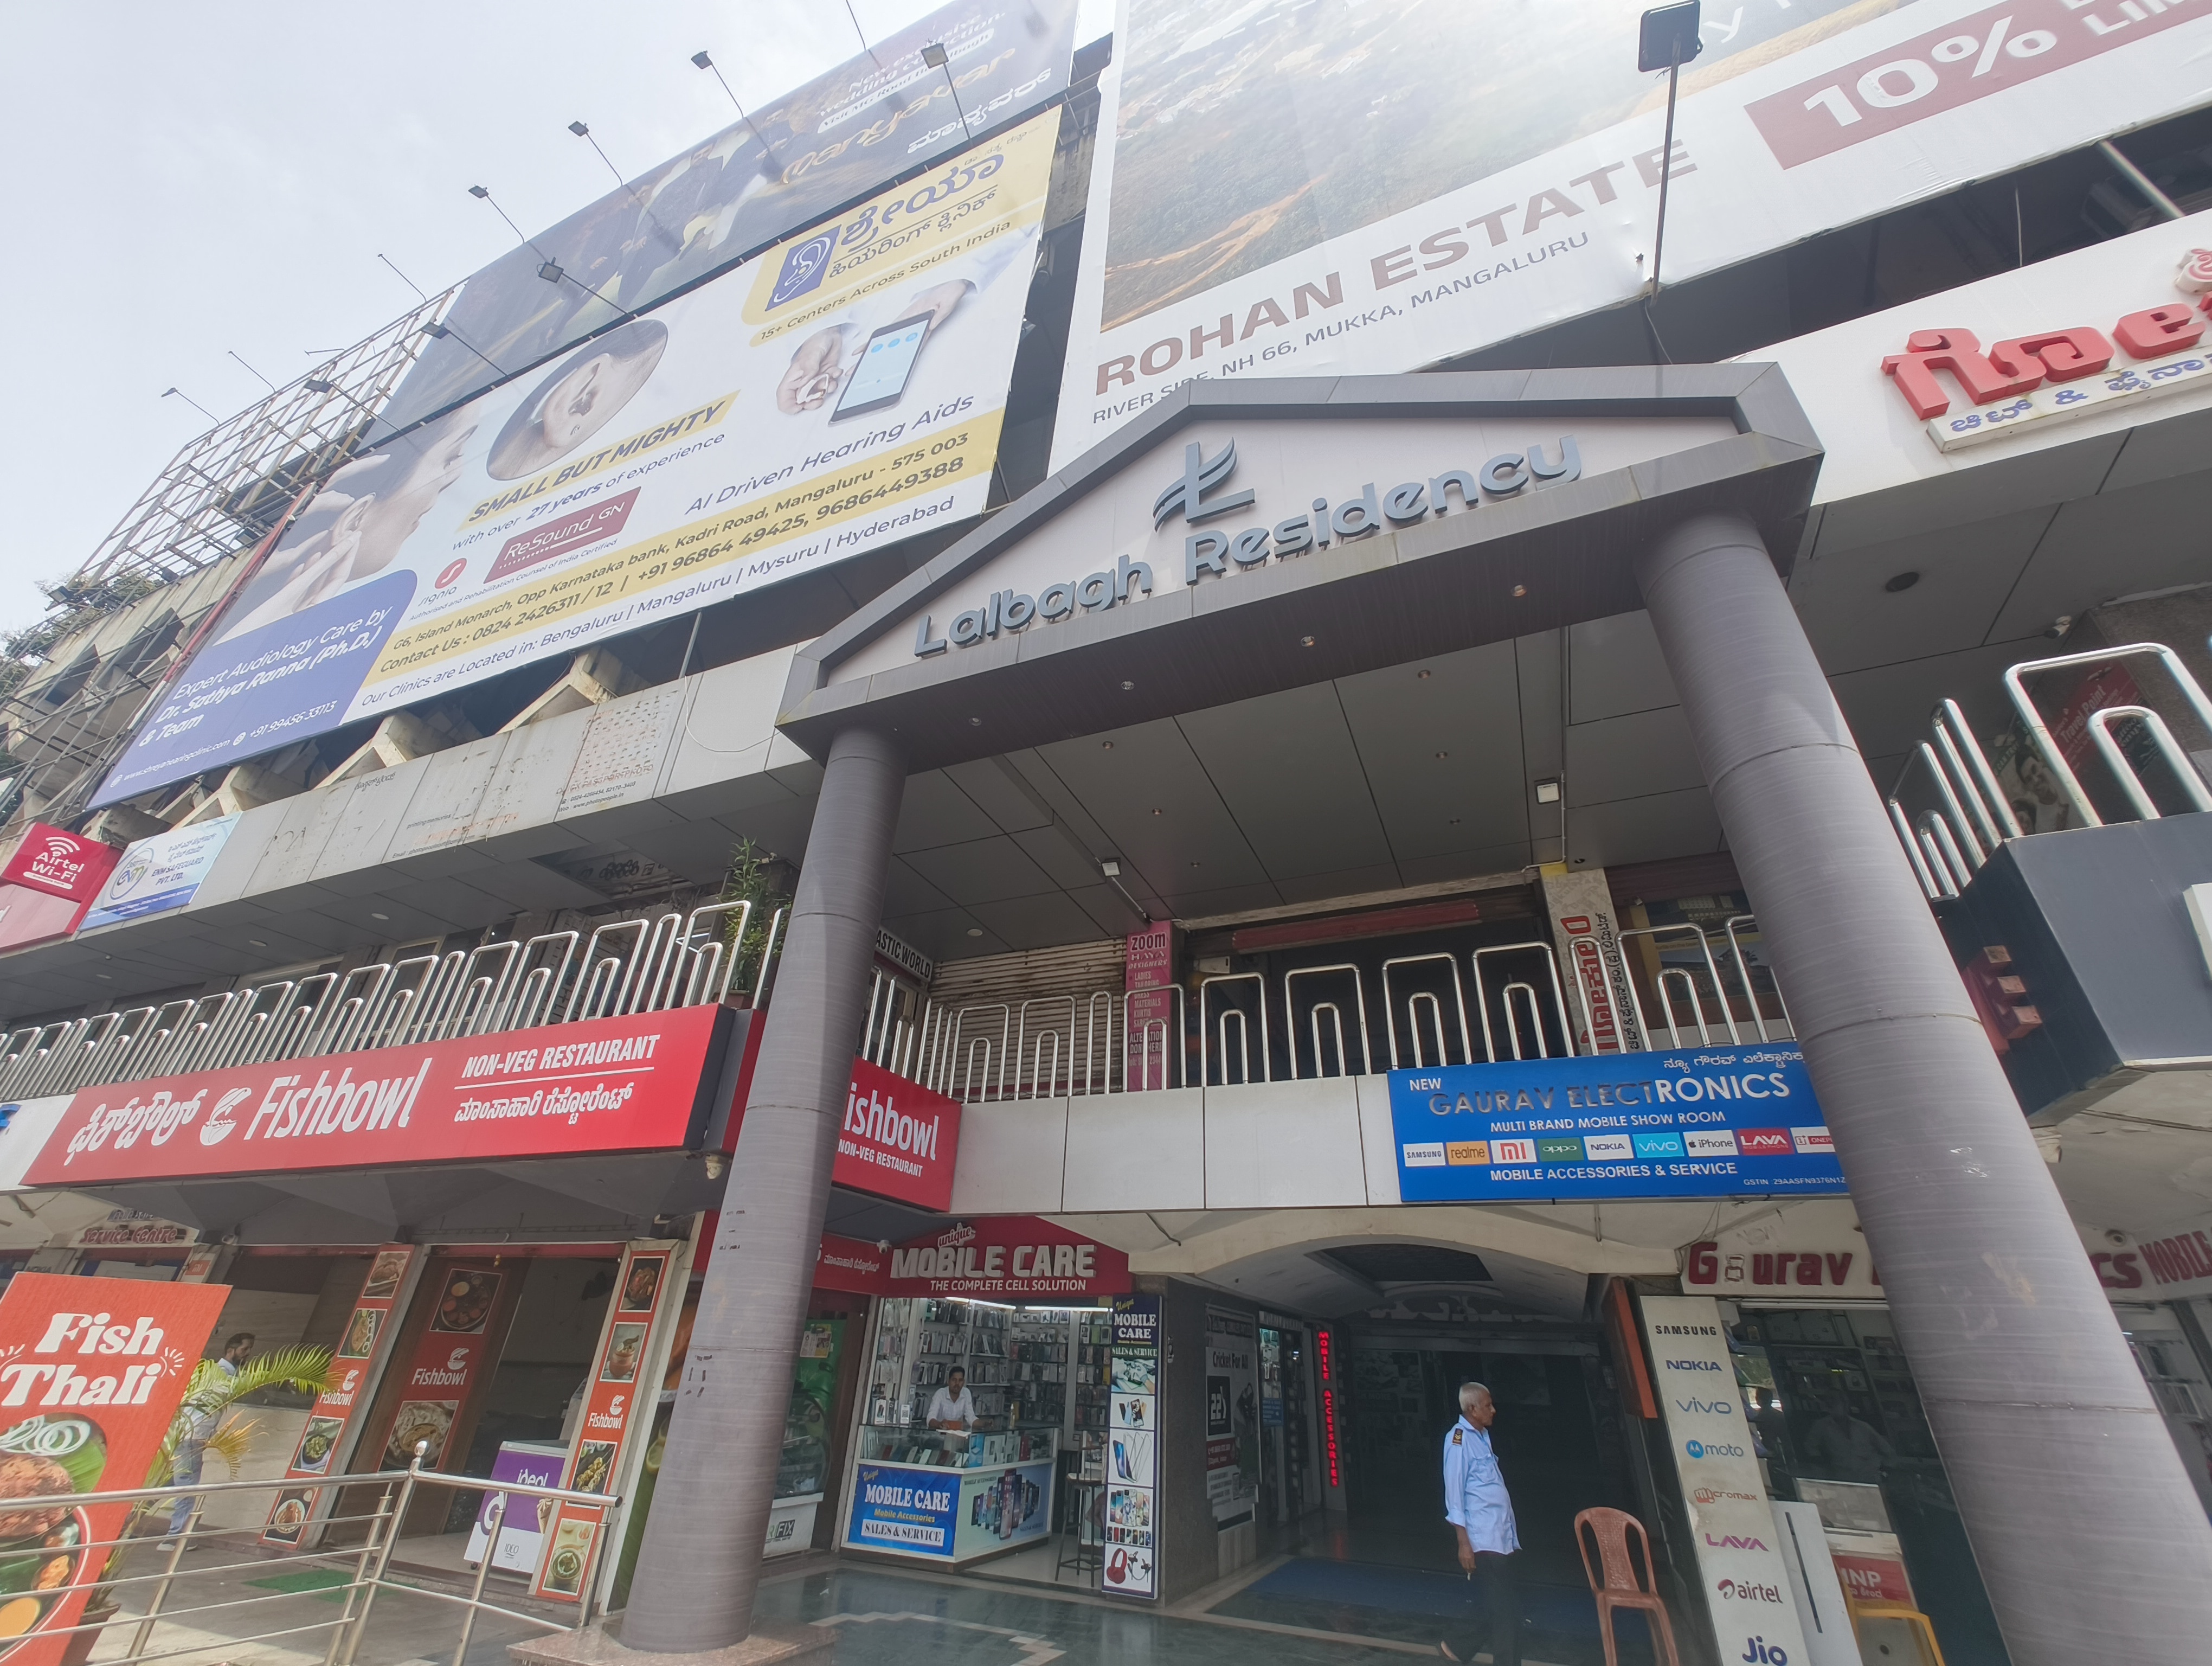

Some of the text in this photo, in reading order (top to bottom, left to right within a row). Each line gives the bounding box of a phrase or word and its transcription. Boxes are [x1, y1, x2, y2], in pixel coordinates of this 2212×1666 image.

[1803, 15, 2057, 127] 10%
[820, 69, 897, 116] wedding
[824, 112, 848, 128] Visit
[1096, 138, 1699, 396] ROHAN ESTATE
[761, 222, 1011, 340] 15+ Centers Across South India
[1093, 230, 1590, 424] RIVER NH 66, MUKKA, MANGALURU
[2055, 389, 2089, 405] &
[468, 400, 725, 522] SMALL BUT MIGHTY
[684, 394, 975, 515] AI Driven Hearing Aids
[452, 434, 725, 551] with over 27 years of experience
[415, 432, 969, 643] Island Monarch, Opp Karnataka bank, Kadri Road, Mangaluru 575 003
[504, 502, 626, 560] ReSound GN
[914, 434, 1584, 658] Lalbagh Residency
[380, 456, 964, 674] Contact 0824 2426311 12 +91 96864 49425, 9686449388
[448, 538, 619, 607] and Certified
[362, 495, 955, 707] Our Clinics are Located in: Bengaluru Mangaluru Mysuru Hyderabad
[172, 605, 394, 701] Expert Audiology Care by
[155, 625, 383, 725] Dr. Sathya Ranna (Ph.D.)
[155, 714, 205, 742] Team
[249, 710, 305, 740] +91 99456
[32, 861, 77, 882] Wi-Fi
[35, 852, 85, 873] Airtel
[156, 877, 170, 886] PVT.
[1134, 971, 1152, 981] LADIES
[1134, 998, 1161, 1008] MATERIALS
[1134, 1008, 1151, 1018] KURTIS
[1624, 1016, 1634, 1026] &
[461, 1034, 660, 1079] NON-VEG RESTAURANT
[1663, 1055, 1737, 1073] ನ್ಯೂ ಗೌರವ್
[1409, 1078, 1442, 1091] NEW
[1429, 1072, 1790, 1116] GAURAV ELECTRONICS
[243, 1057, 433, 1140] Fishbowl
[454, 1082, 634, 1125] ಮಾಂಸಾಹಾರಿ ರೆಸ್ಟೋರೆಂಟ್
[844, 1082, 940, 1161] ishbowl
[1490, 1111, 1726, 1133] MULTI BRAND MOBILE SHOW ROOM
[838, 1138, 923, 1177] NON-VEG RESTAURANT
[1407, 1135, 1788, 1159] SAMSUNG realme oppo NOKIA vivo iPhone LAVA
[1490, 1162, 1739, 1183] MOBILE ACCESSORIES & SERVICE
[79, 1227, 130, 1244] Service
[938, 1222, 976, 1247] unique
[890, 1244, 1097, 1279] MOBILE CARE
[930, 1280, 1087, 1291] THE COMPLETE CELL SOLUTION
[1114, 1313, 1156, 1326] MOBILE
[1655, 1324, 1717, 1336] SAMSUNG
[34, 1312, 164, 1355] Fish
[1118, 1327, 1152, 1339] CARE
[1112, 1347, 1158, 1356] SALES SERVICE
[1212, 1350, 1231, 1369] Cricket
[411, 1368, 467, 1386] Fishbowl
[1666, 1360, 1722, 1372] NOKIA
[1, 1362, 164, 1406] Thali
[1318, 1331, 1339, 1488] MOBILE ACCESSORIES
[1676, 1396, 1732, 1414] vivo
[587, 1412, 624, 1430] Fishbowl
[1705, 1441, 1745, 1458] moto
[864, 1484, 950, 1512] MOBILE CARE
[873, 1508, 936, 1523] Mobile Accessories
[864, 1522, 942, 1542] SALES & SERVICE
[1705, 1533, 1770, 1552] LAVA
[1737, 1580, 1783, 1604] airtel
[1742, 1635, 1788, 1666] Jio
